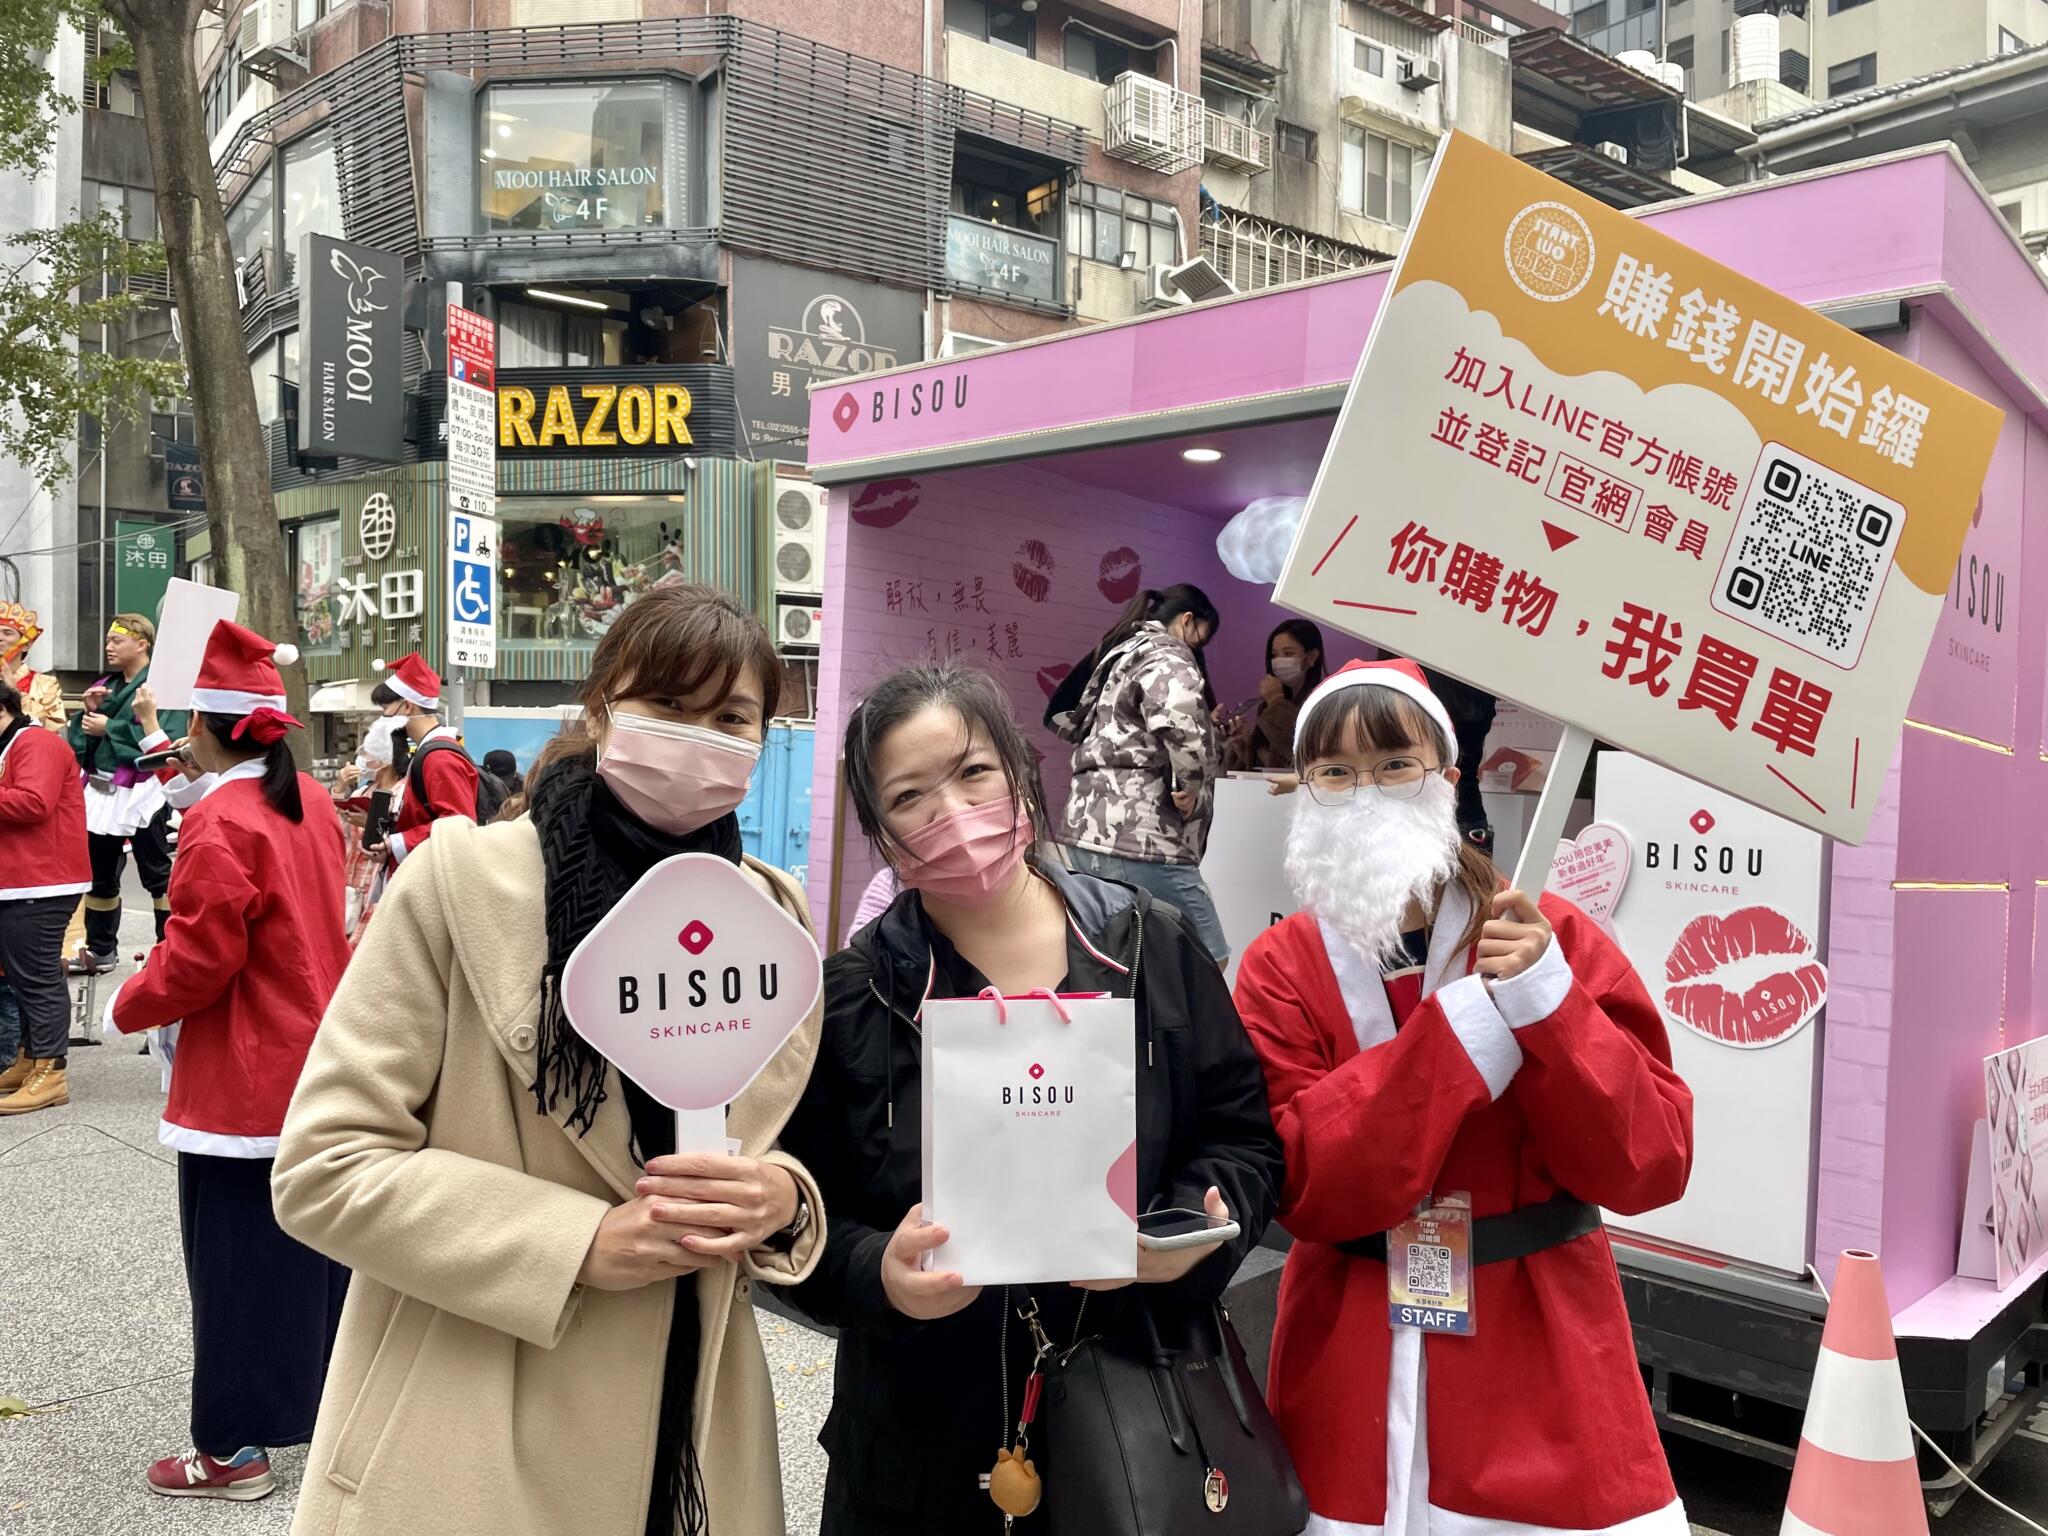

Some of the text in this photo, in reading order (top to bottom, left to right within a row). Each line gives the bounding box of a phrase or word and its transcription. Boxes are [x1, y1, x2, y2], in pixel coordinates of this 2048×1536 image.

[495, 167, 657, 189] MOOI HAIR SALON
[982, 236, 1010, 255] HAIR
[1012, 244, 1050, 264] SALON
[346, 316, 373, 404] MOOI
[1596, 250, 1932, 468] 賺錢開始鑼
[323, 361, 335, 441] HAIR SALON
[499, 383, 694, 446] RAZOR
[872, 375, 968, 423] BISOU
[1444, 346, 1739, 512] 加入LINE官方帳號
[1430, 406, 1711, 561] 並登記 官網 會員
[474, 499, 487, 512] 110
[125, 550, 167, 563] 沐田
[1788, 540, 1832, 573] LINE
[336, 569, 424, 626] 沐田
[1945, 552, 2004, 633] ISOU
[474, 653, 488, 663] 110
[1948, 637, 1990, 673] SKINCARE
[1646, 842, 1762, 876] BISOU
[1665, 881, 1740, 895] SKINCARE
[618, 963, 778, 1014] BISOU
[1752, 993, 1796, 1022] BISOU
[650, 1019, 752, 1039] SKINCARE
[1002, 1086, 1074, 1105] BISOU
[1402, 1308, 1457, 1328] STAFF
[185, 1460, 208, 1485] N
